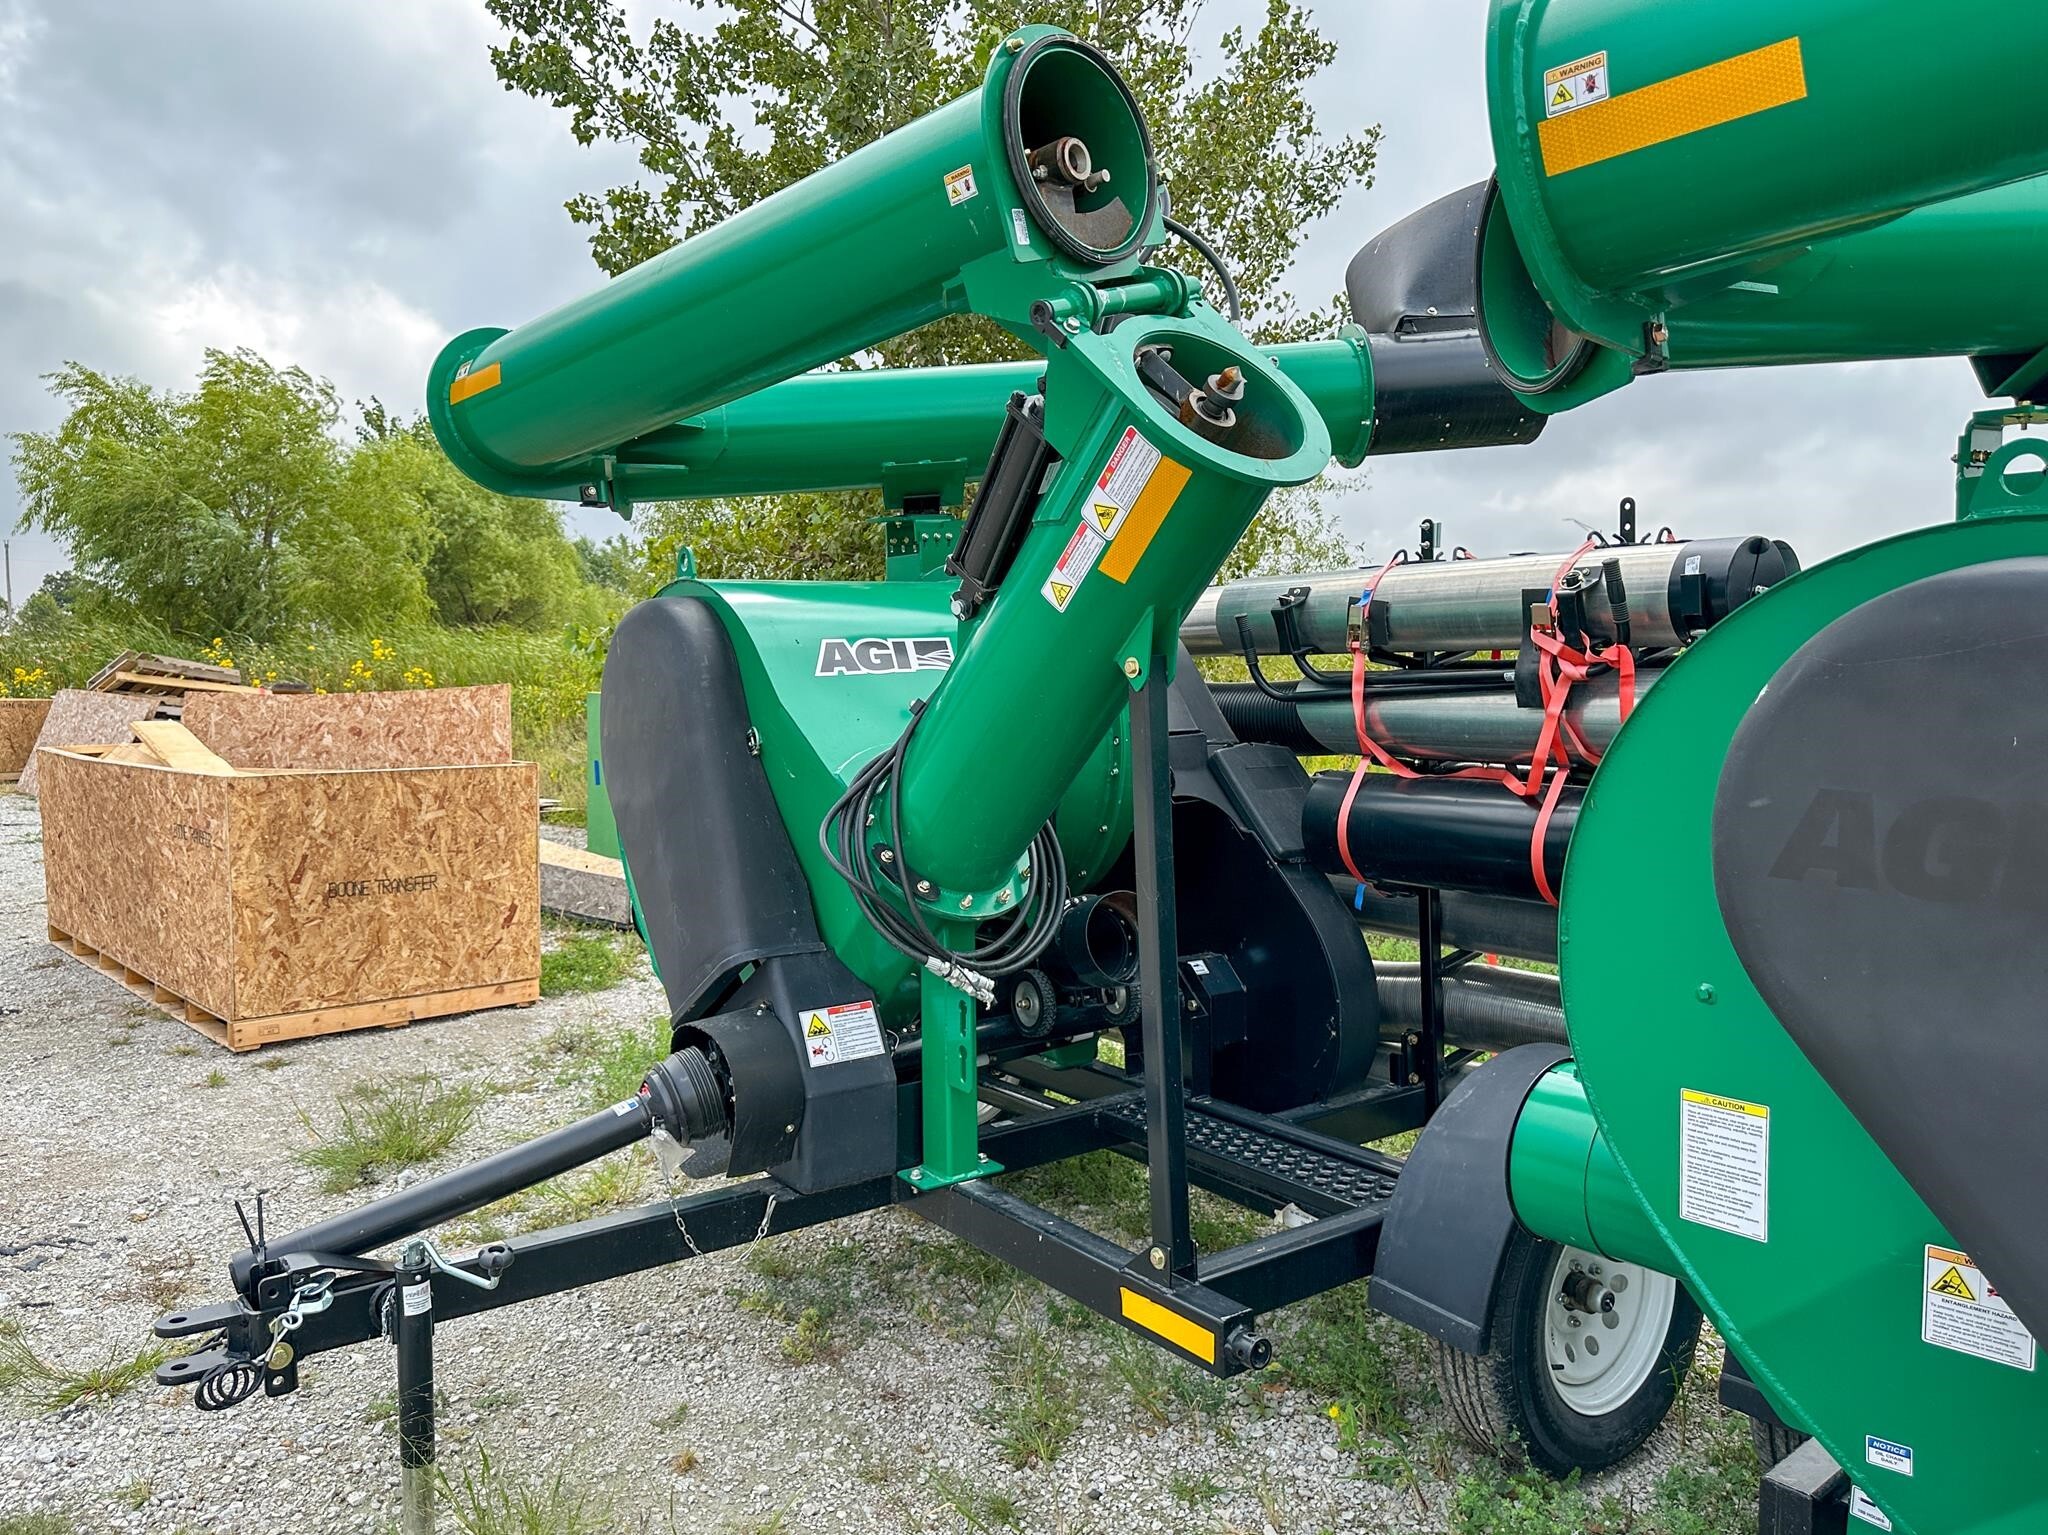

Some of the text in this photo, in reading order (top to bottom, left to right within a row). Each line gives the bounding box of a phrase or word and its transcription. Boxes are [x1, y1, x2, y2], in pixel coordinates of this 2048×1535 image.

[1559, 57, 1602, 78] WARNING
[1110, 435, 1131, 469] DANGER
[817, 639, 914, 675] AGI
[328, 874, 438, 898] BOONE TRANSFER
[1711, 1098, 1745, 1112] CAUTION
[1941, 1298, 2017, 1322] ENTANGLEMENT HAZARD
[1872, 1440, 1907, 1456] NOTICE
[1885, 1453, 1904, 1463] CHAIN
